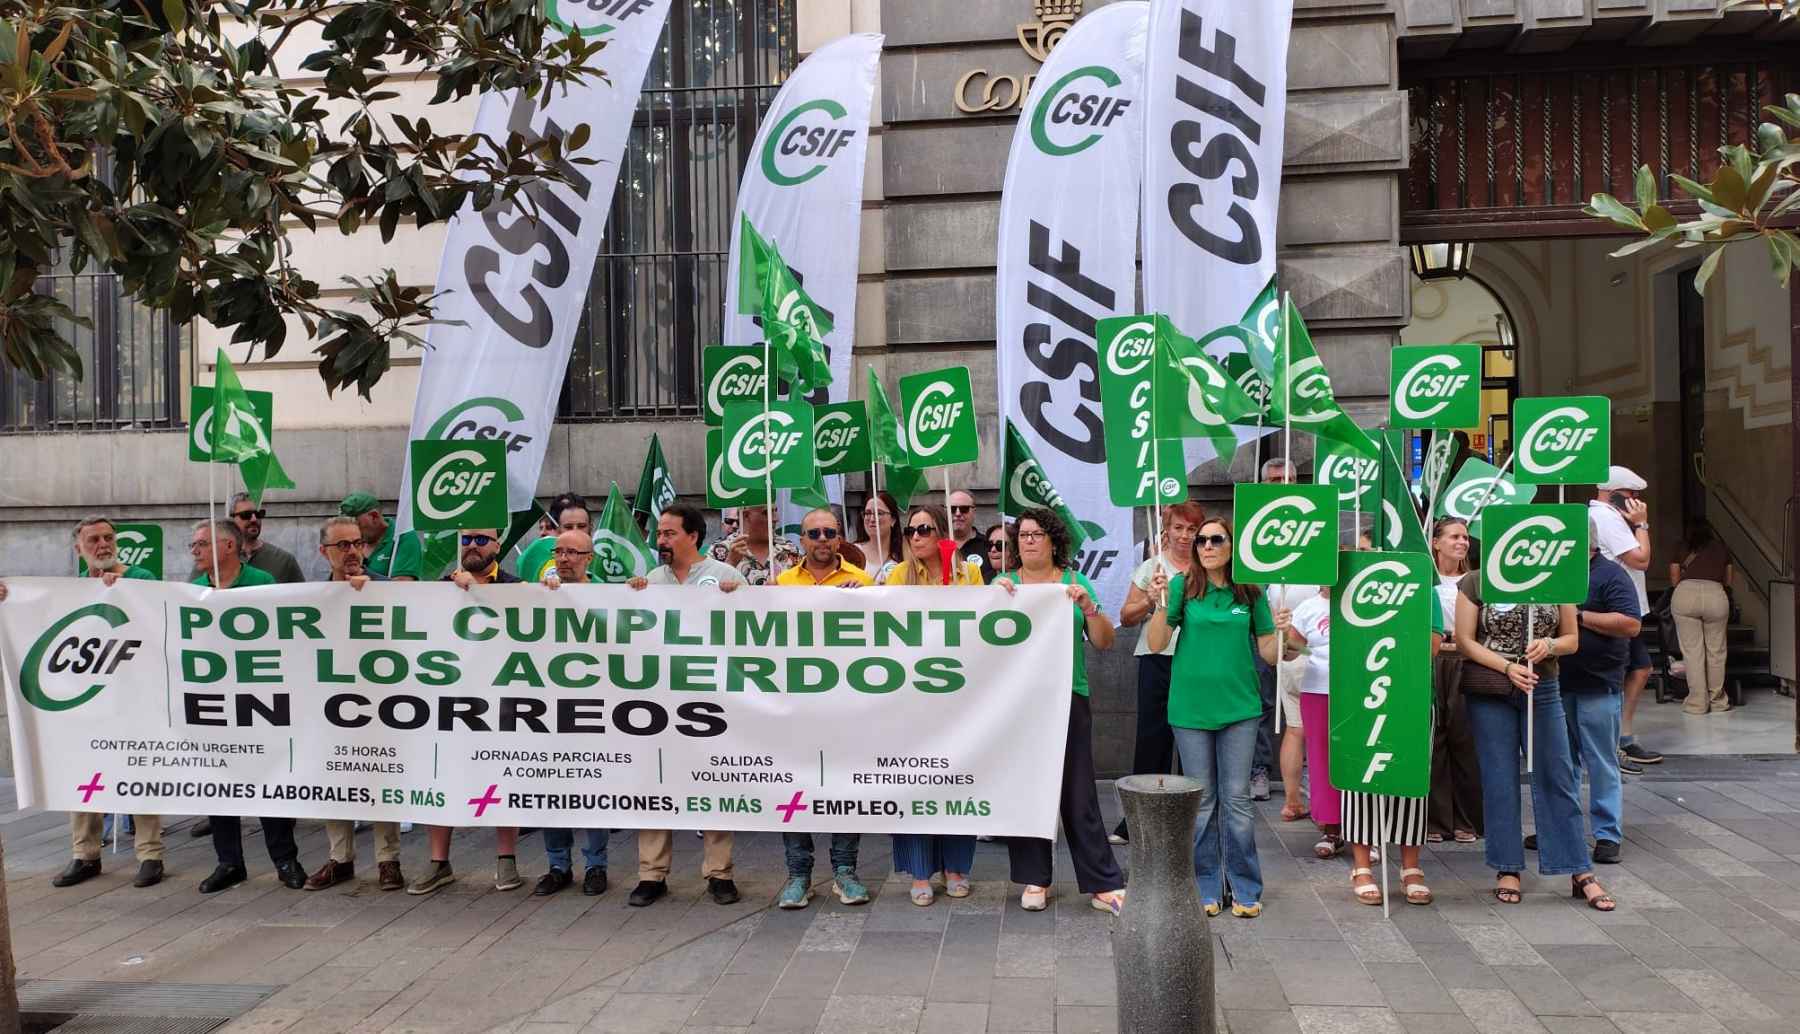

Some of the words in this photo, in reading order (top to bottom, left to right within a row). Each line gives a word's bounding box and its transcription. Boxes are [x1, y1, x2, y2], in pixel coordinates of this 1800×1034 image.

[1051, 92, 1132, 127] CSIF
[781, 125, 856, 158] CSIF
[1168, 8, 1266, 265] CSIF
[1020, 218, 1116, 464] CSIF
[1409, 374, 1470, 397] CSIF
[919, 401, 964, 432] CSIF
[742, 432, 803, 455] CSIF
[817, 426, 860, 449] CSIF
[1534, 427, 1599, 452] CSIF
[432, 471, 496, 496] CSIF
[1256, 519, 1326, 547] CSIF
[117, 546, 153, 565] SIF
[1504, 538, 1576, 567] CSIF
[1356, 581, 1420, 606] CSIF
[180, 605, 326, 640] POR
[348, 605, 428, 640] EL
[452, 605, 1032, 647] CUMPLIMIENTO
[48, 636, 143, 674] CSIF
[181, 648, 284, 684] DE
[316, 648, 462, 686] LOS
[491, 651, 966, 694] ACUERDOS
[184, 692, 291, 727] EN
[323, 693, 728, 738] CORREOS
[1362, 637, 1396, 783] CSIF
[90, 738, 199, 751] CONTRATACIÓN
[202, 743, 265, 754] URGENTE
[334, 745, 348, 756] 35
[351, 746, 397, 758] HORAS
[471, 750, 549, 762] JORNADAS
[552, 752, 632, 764] PARCIALES
[127, 756, 147, 766] DE
[152, 757, 228, 768] PLANTILLA
[326, 761, 405, 774] SEMANALES
[503, 766, 513, 777] A
[516, 767, 602, 779] COMPLETAS
[710, 755, 774, 767] SALIDAS
[876, 757, 950, 769] MAYORES
[691, 770, 793, 784] VOLUNTARIAS
[853, 773, 975, 786] RETRIBUCIONES
[116, 781, 256, 799] CONDICIONES
[262, 784, 376, 807] LABORALES,
[382, 788, 405, 804] ES
[410, 785, 446, 808] MÁS
[509, 792, 680, 816] RETRIBUCIONES,
[686, 796, 712, 813] ES
[719, 793, 762, 814] MÁS
[812, 799, 905, 819] EMPLEO,
[911, 800, 938, 816] ES
[946, 796, 991, 817] MÁS
